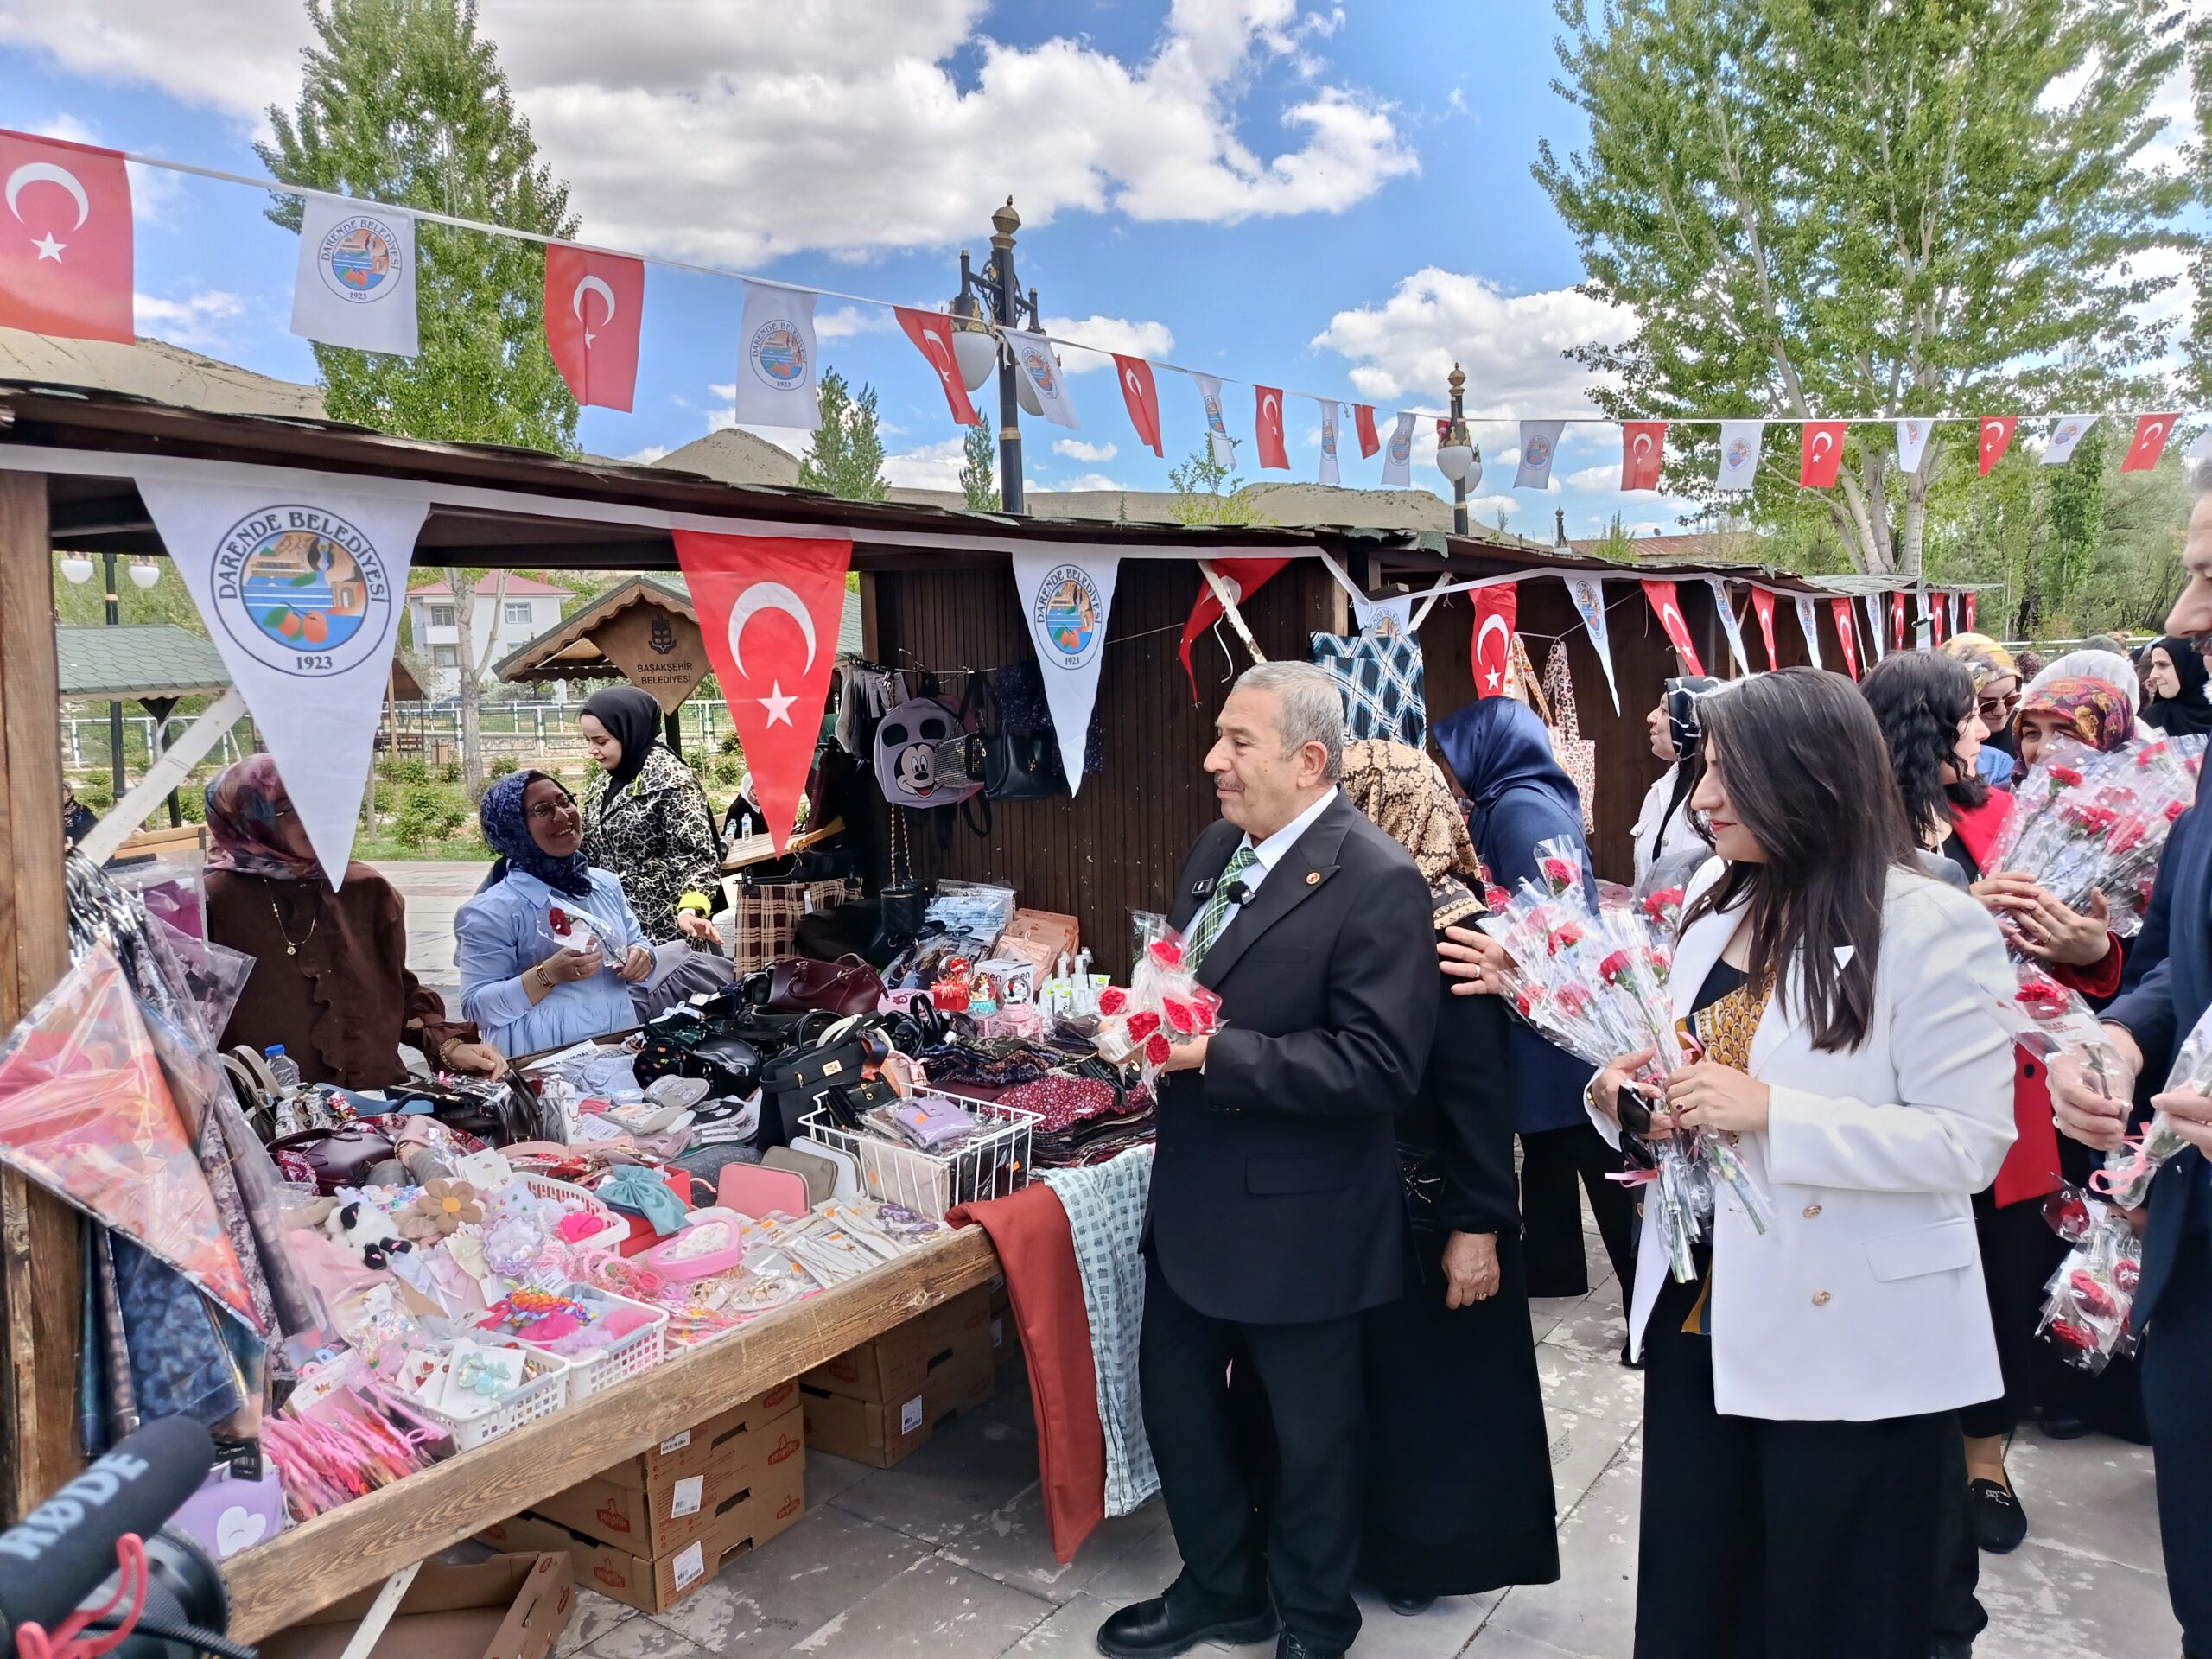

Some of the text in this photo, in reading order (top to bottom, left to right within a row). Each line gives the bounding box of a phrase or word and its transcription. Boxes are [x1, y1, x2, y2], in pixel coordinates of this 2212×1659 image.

[321, 219, 401, 270] DARENDE BELEDİYESİ
[752, 323, 778, 358] DARENDE
[219, 512, 390, 603] DARENDE BELEDİYESİ
[1037, 569, 1102, 624] DARENDE BELEDİYESİ
[296, 656, 333, 670] 1923
[637, 662, 693, 674] BAŞAKŞEHİR
[1065, 657, 1080, 665] 1923
[641, 674, 691, 684] BELEDİYESİ
